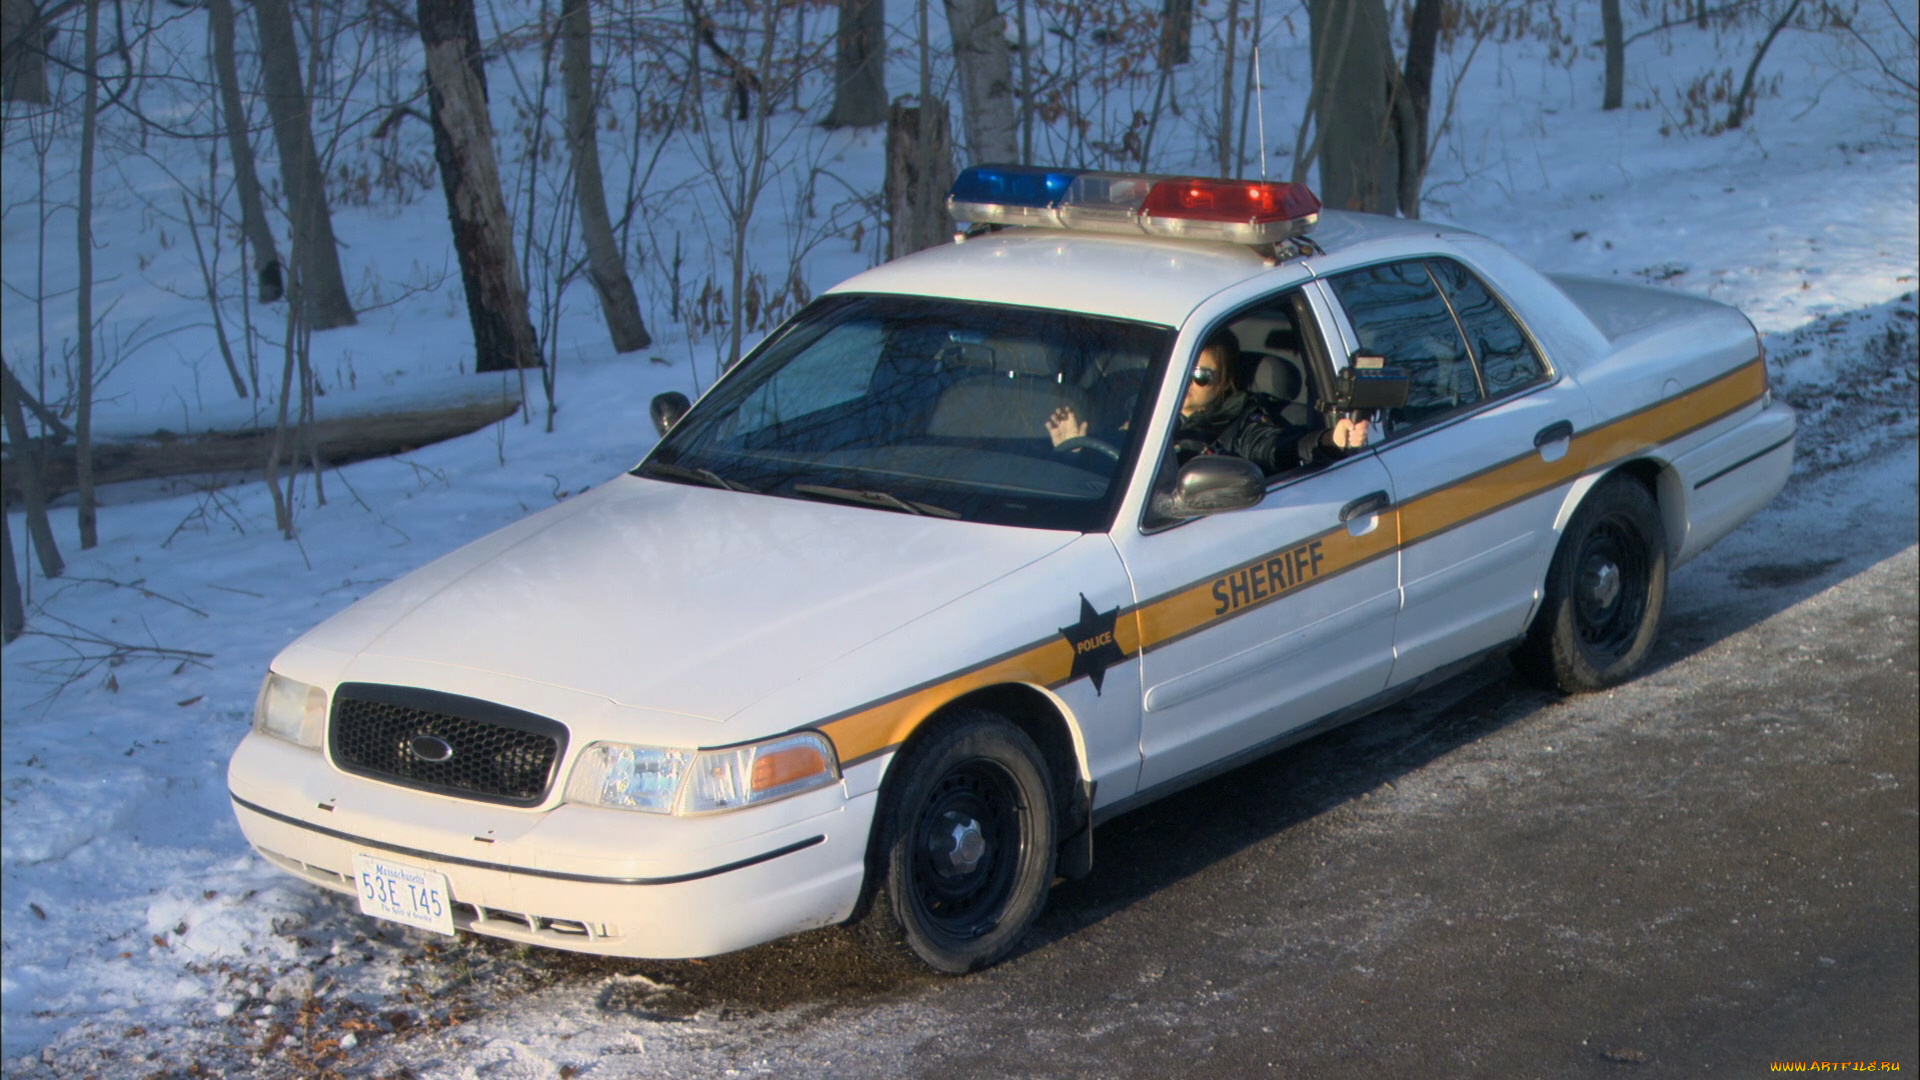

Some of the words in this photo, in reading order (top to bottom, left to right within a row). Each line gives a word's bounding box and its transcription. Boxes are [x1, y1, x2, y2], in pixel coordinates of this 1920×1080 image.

[1212, 540, 1324, 615] SHERIFF
[1077, 631, 1113, 655] POLICE
[362, 872, 400, 907] 53E
[408, 884, 442, 917] T45
